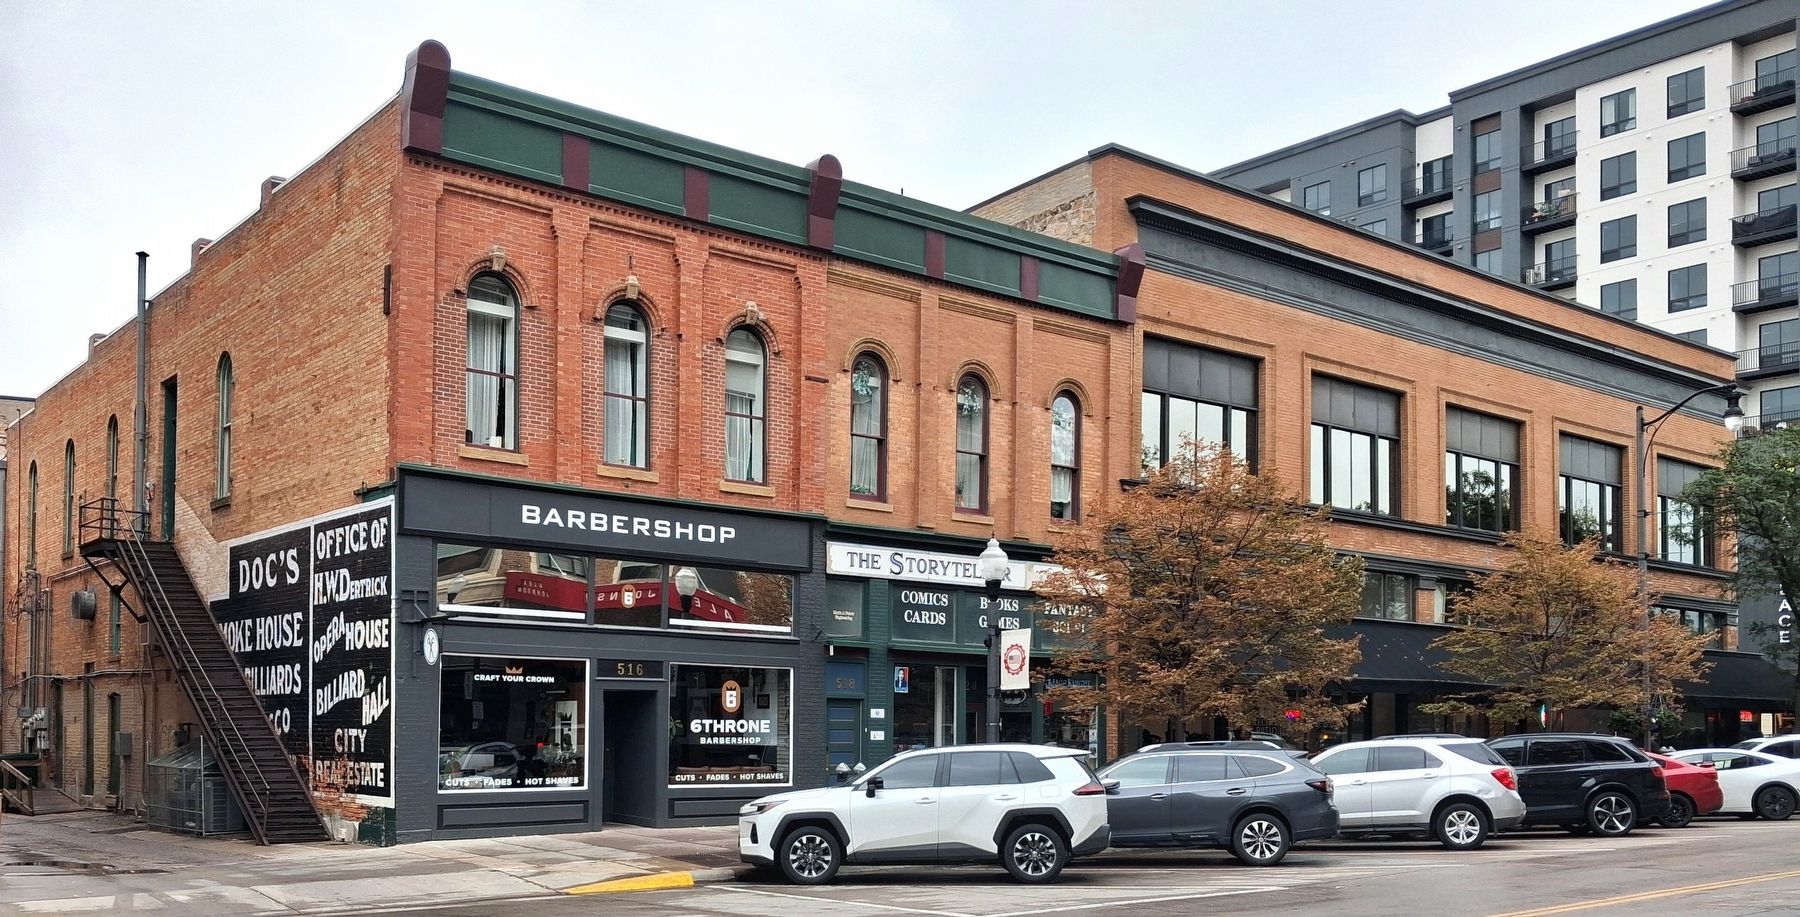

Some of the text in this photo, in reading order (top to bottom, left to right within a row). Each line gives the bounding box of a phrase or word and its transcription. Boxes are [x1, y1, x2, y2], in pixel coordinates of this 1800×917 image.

[521, 504, 736, 544] BARBERSHOP
[316, 517, 389, 560] OFFICE OF
[238, 547, 300, 593] DOC'S
[846, 551, 882, 570] THE
[889, 552, 1012, 583] STORYTELR
[901, 590, 949, 607] COMICS
[904, 610, 946, 626] CARDS
[979, 615, 1020, 630] GMES
[256, 612, 304, 650] HOUSE
[313, 610, 389, 664] OPERA HOUSE
[474, 674, 501, 682] CRAFT
[617, 662, 644, 676] 516
[316, 669, 390, 726] BILLIARD HALL
[725, 690, 737, 708] 6
[690, 719, 771, 733] 6THRONE
[334, 728, 367, 753] CITY
[699, 737, 761, 745] BARBERSHOP
[346, 762, 385, 788] ESTATE
[445, 776, 579, 787] CUTS FADES HOT SHAVES
[675, 774, 696, 782] CUTS
[756, 772, 784, 780] SHAVES
